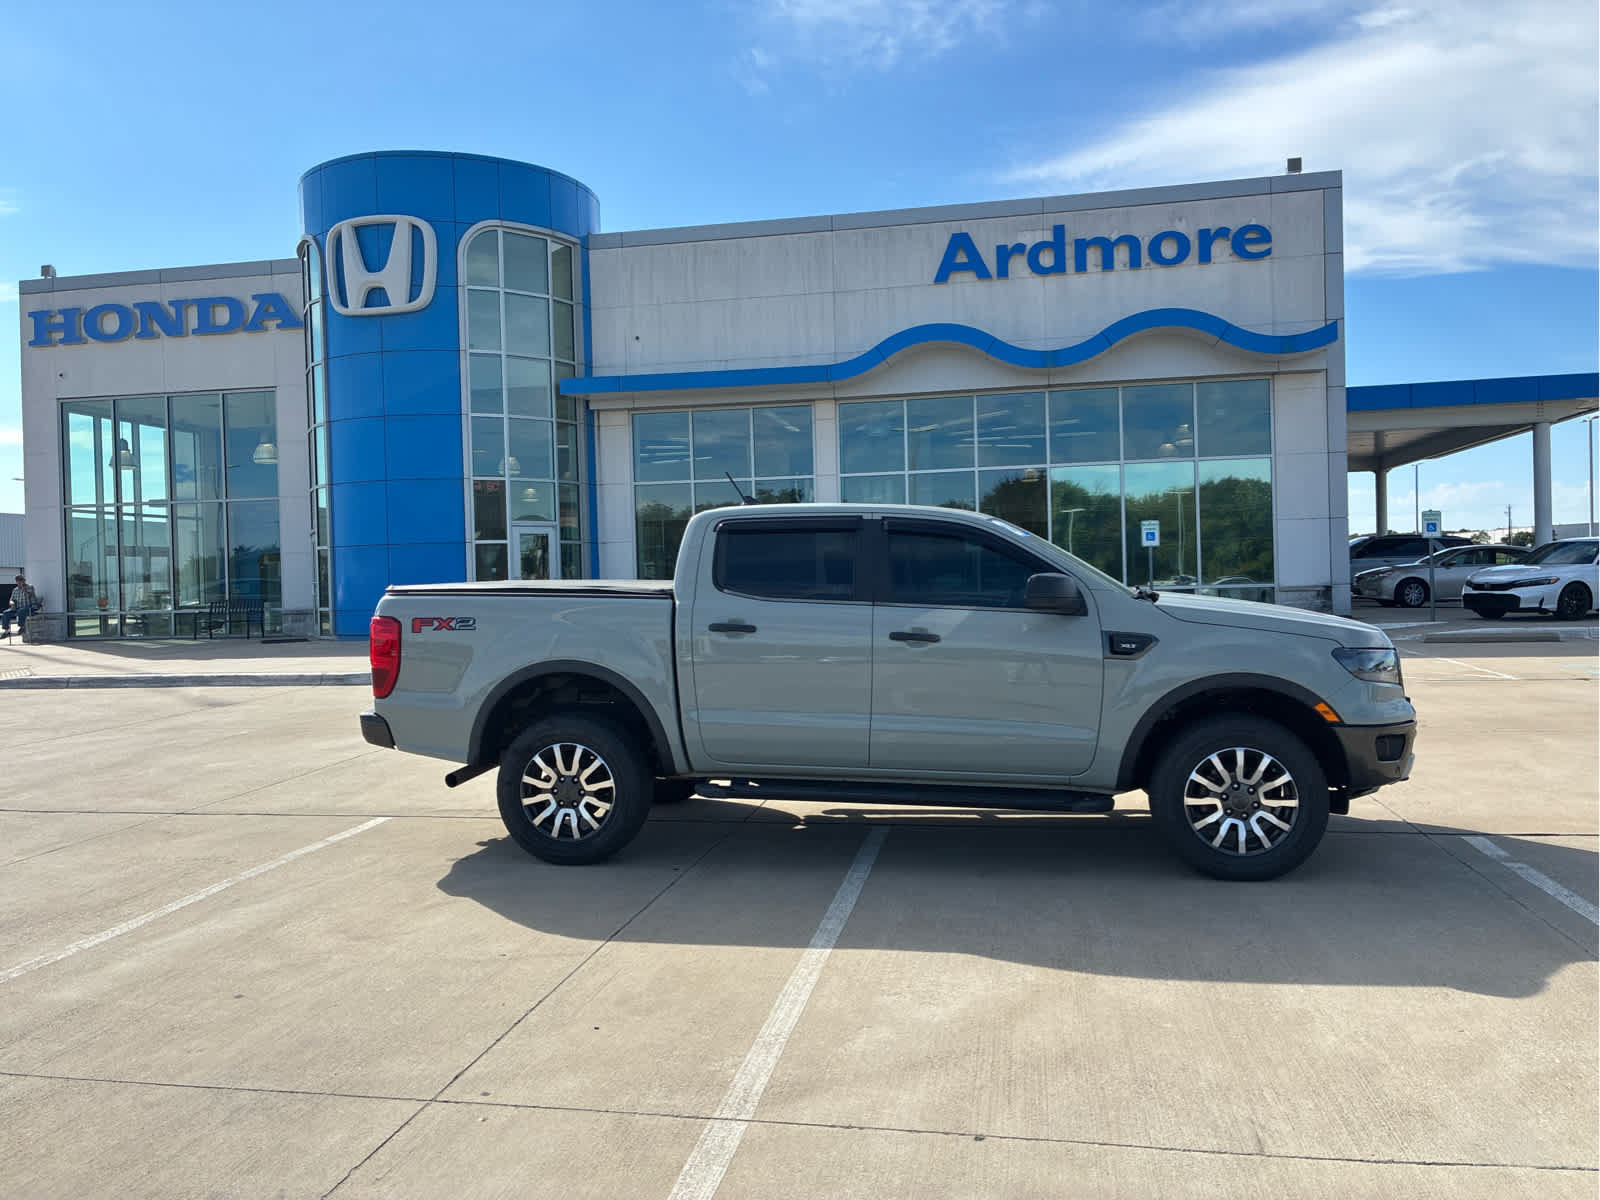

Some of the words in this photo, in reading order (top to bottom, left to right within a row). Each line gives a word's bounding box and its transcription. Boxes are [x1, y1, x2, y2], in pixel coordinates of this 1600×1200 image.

[933, 224, 1273, 284] Ardmore
[27, 293, 303, 347] HONDA
[411, 616, 477, 633] FX2
